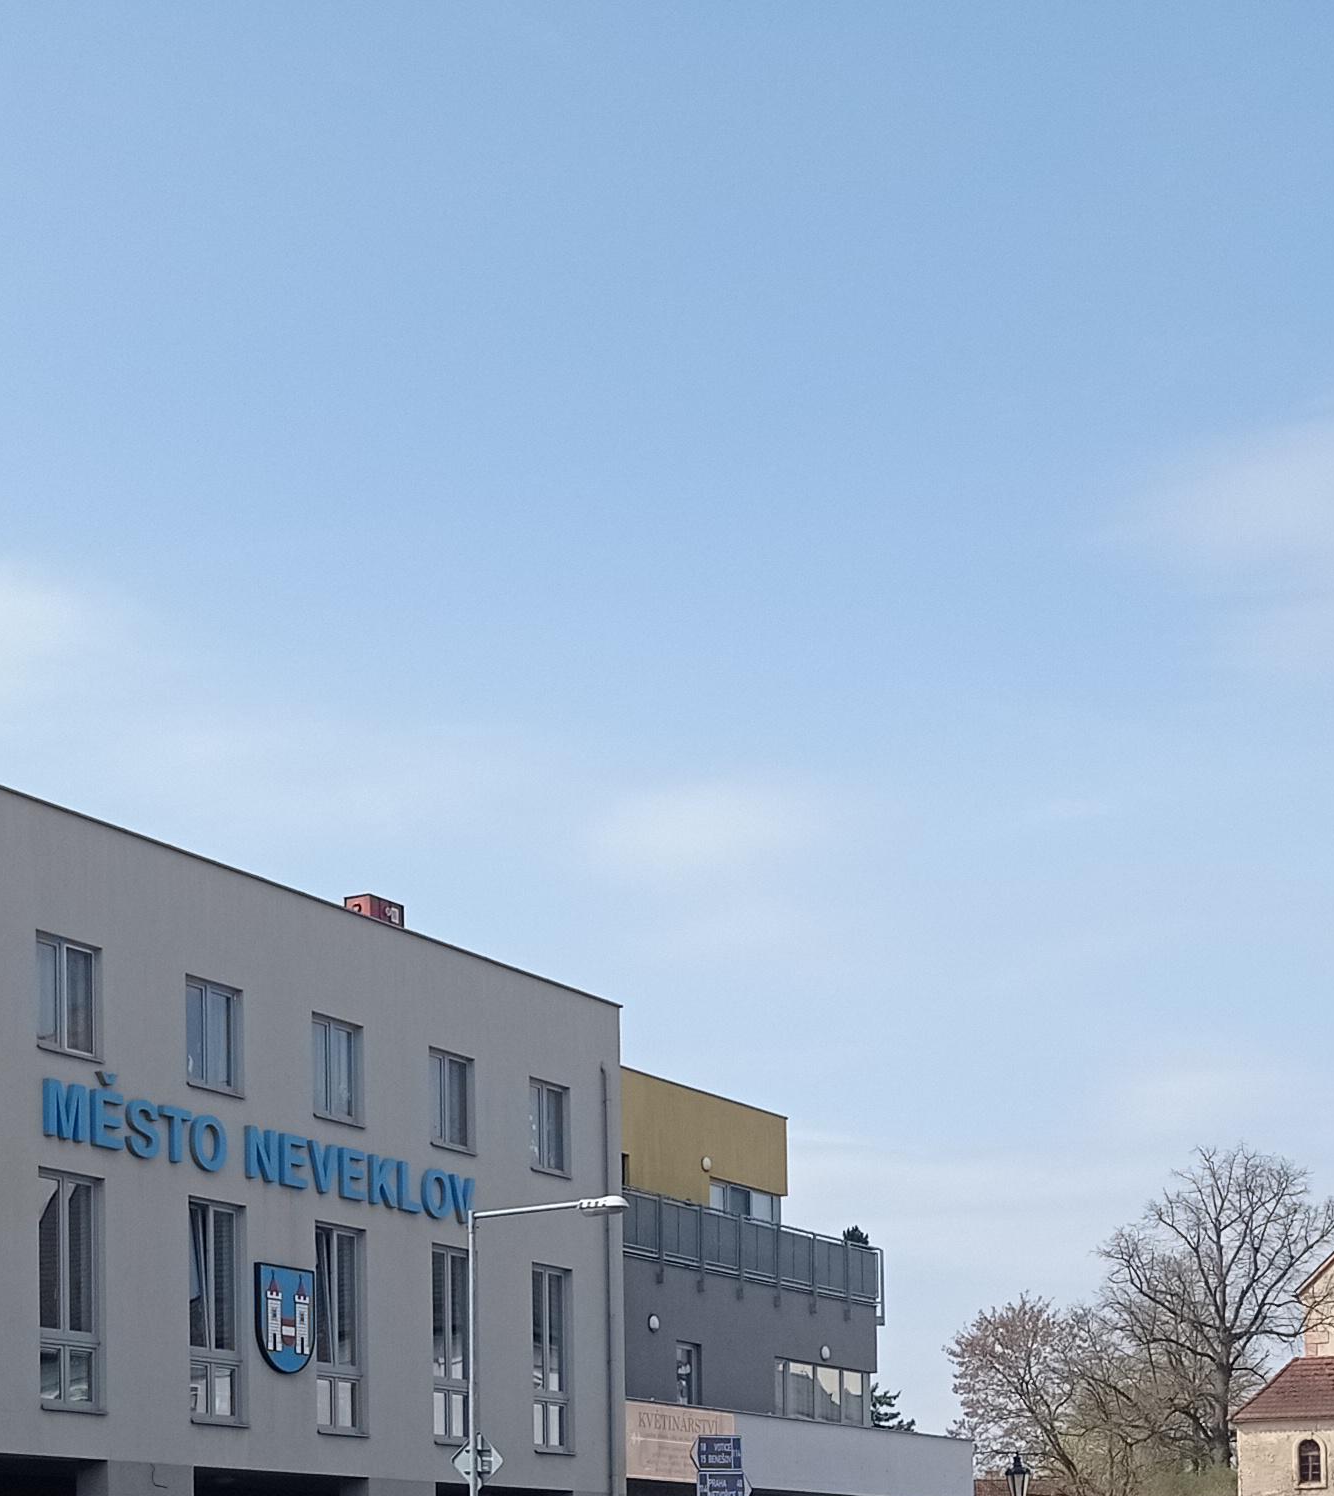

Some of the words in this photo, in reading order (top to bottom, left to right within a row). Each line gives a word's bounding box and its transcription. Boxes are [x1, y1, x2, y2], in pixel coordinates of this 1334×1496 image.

[43, 1070, 227, 1172] MĚSTO
[244, 1125, 476, 1223] NEVEKLOV
[638, 1410, 718, 1435] KVĚTINÁŘSTVÍ
